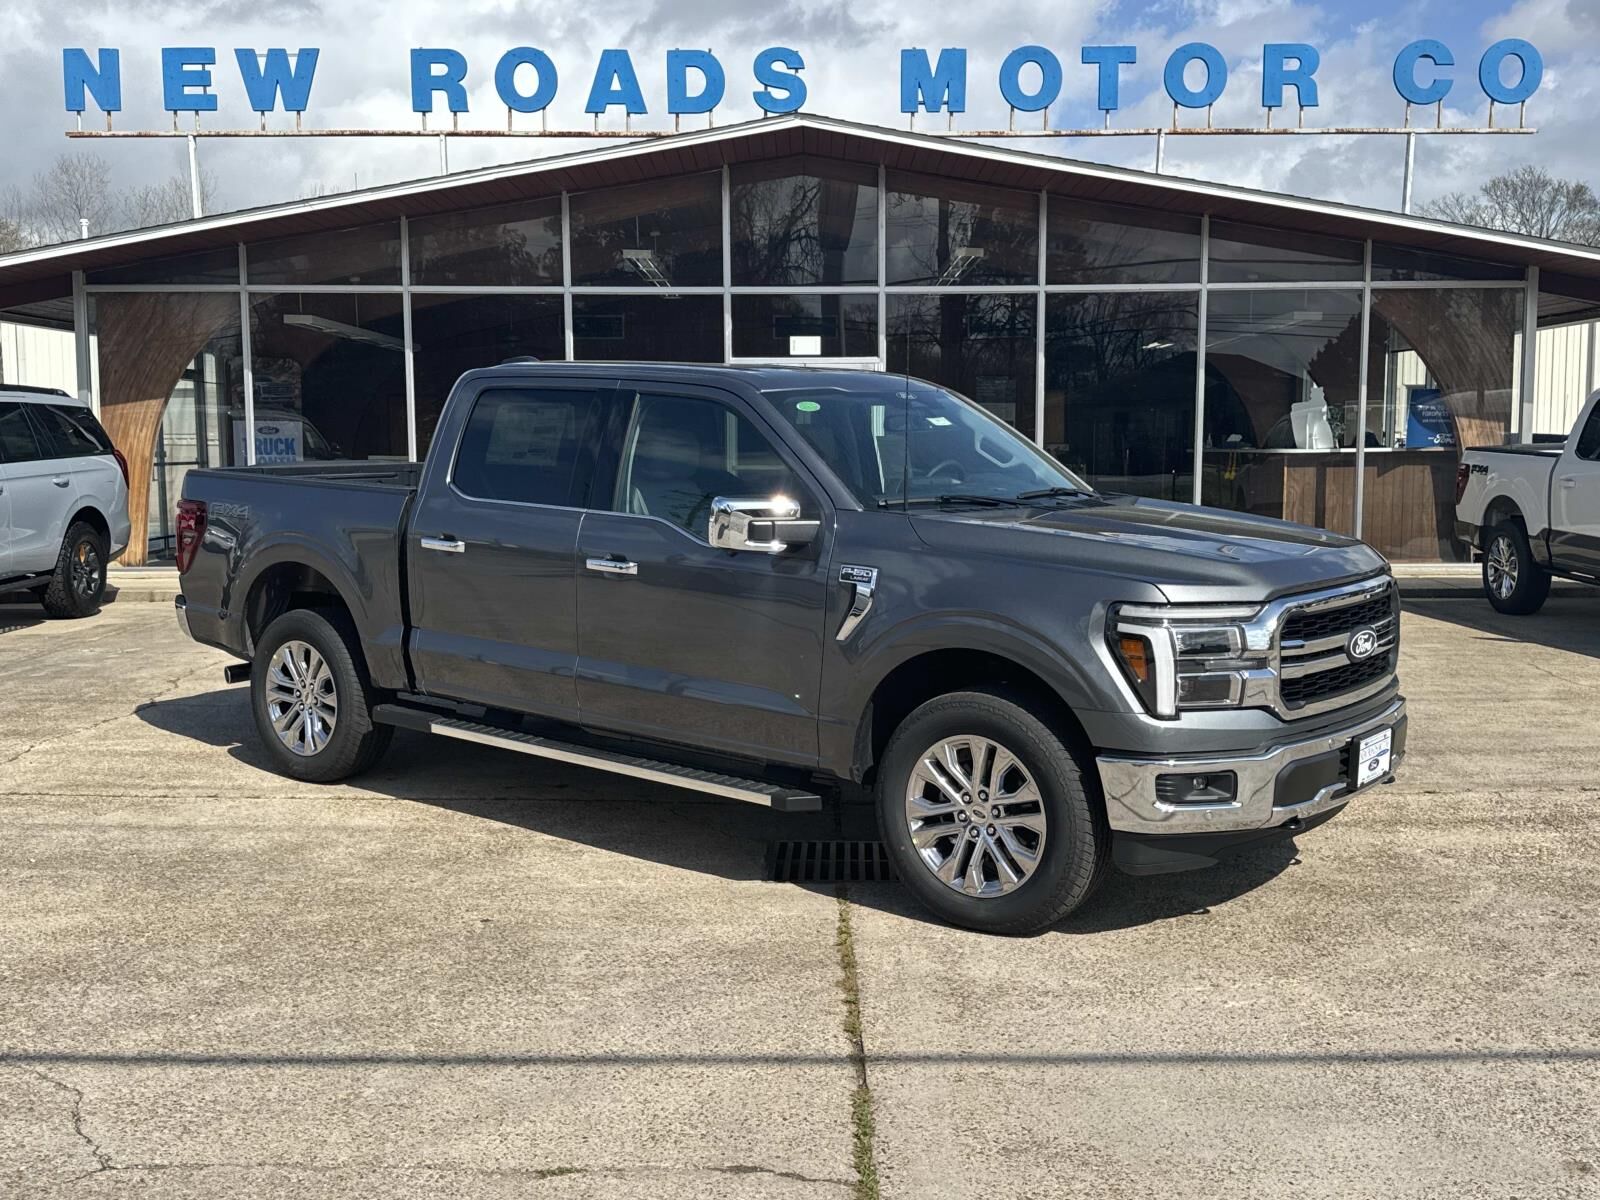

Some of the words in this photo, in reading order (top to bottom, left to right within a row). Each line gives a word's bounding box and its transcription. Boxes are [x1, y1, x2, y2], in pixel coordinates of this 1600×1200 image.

[63, 47, 317, 111] NEW
[411, 46, 807, 114] ROADS
[900, 43, 1319, 113] MOTOR
[1392, 39, 1543, 105] CO
[1471, 464, 1489, 475] FX4
[209, 501, 249, 520] FX4
[841, 567, 872, 577] F-150
[1355, 634, 1373, 655] Ford
